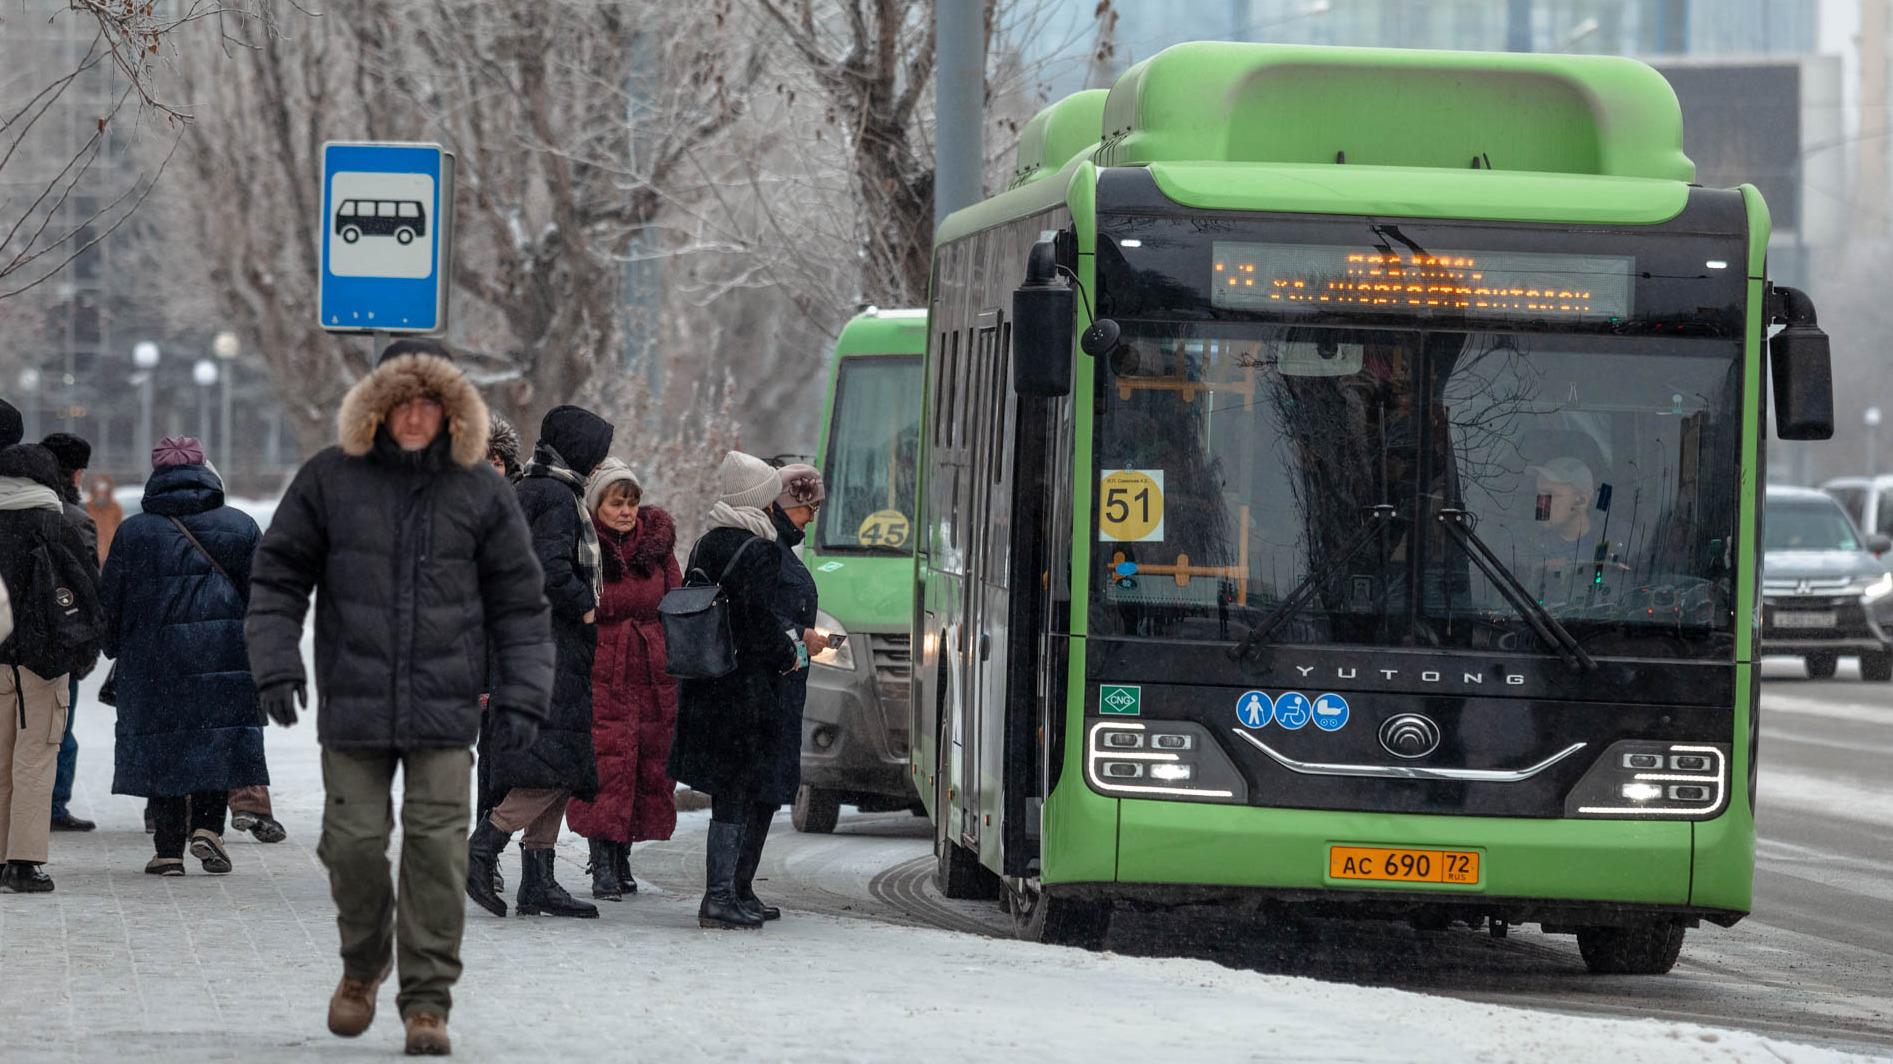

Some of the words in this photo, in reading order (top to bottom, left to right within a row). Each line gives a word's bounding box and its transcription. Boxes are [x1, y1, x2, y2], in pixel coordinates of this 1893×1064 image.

[1106, 488, 1149, 523] 51
[861, 523, 906, 545] 45
[1296, 666, 1525, 685] YUTONG
[1110, 695, 1131, 706] CNG
[1384, 853, 1431, 877] 690
[1446, 855, 1470, 874] 72
